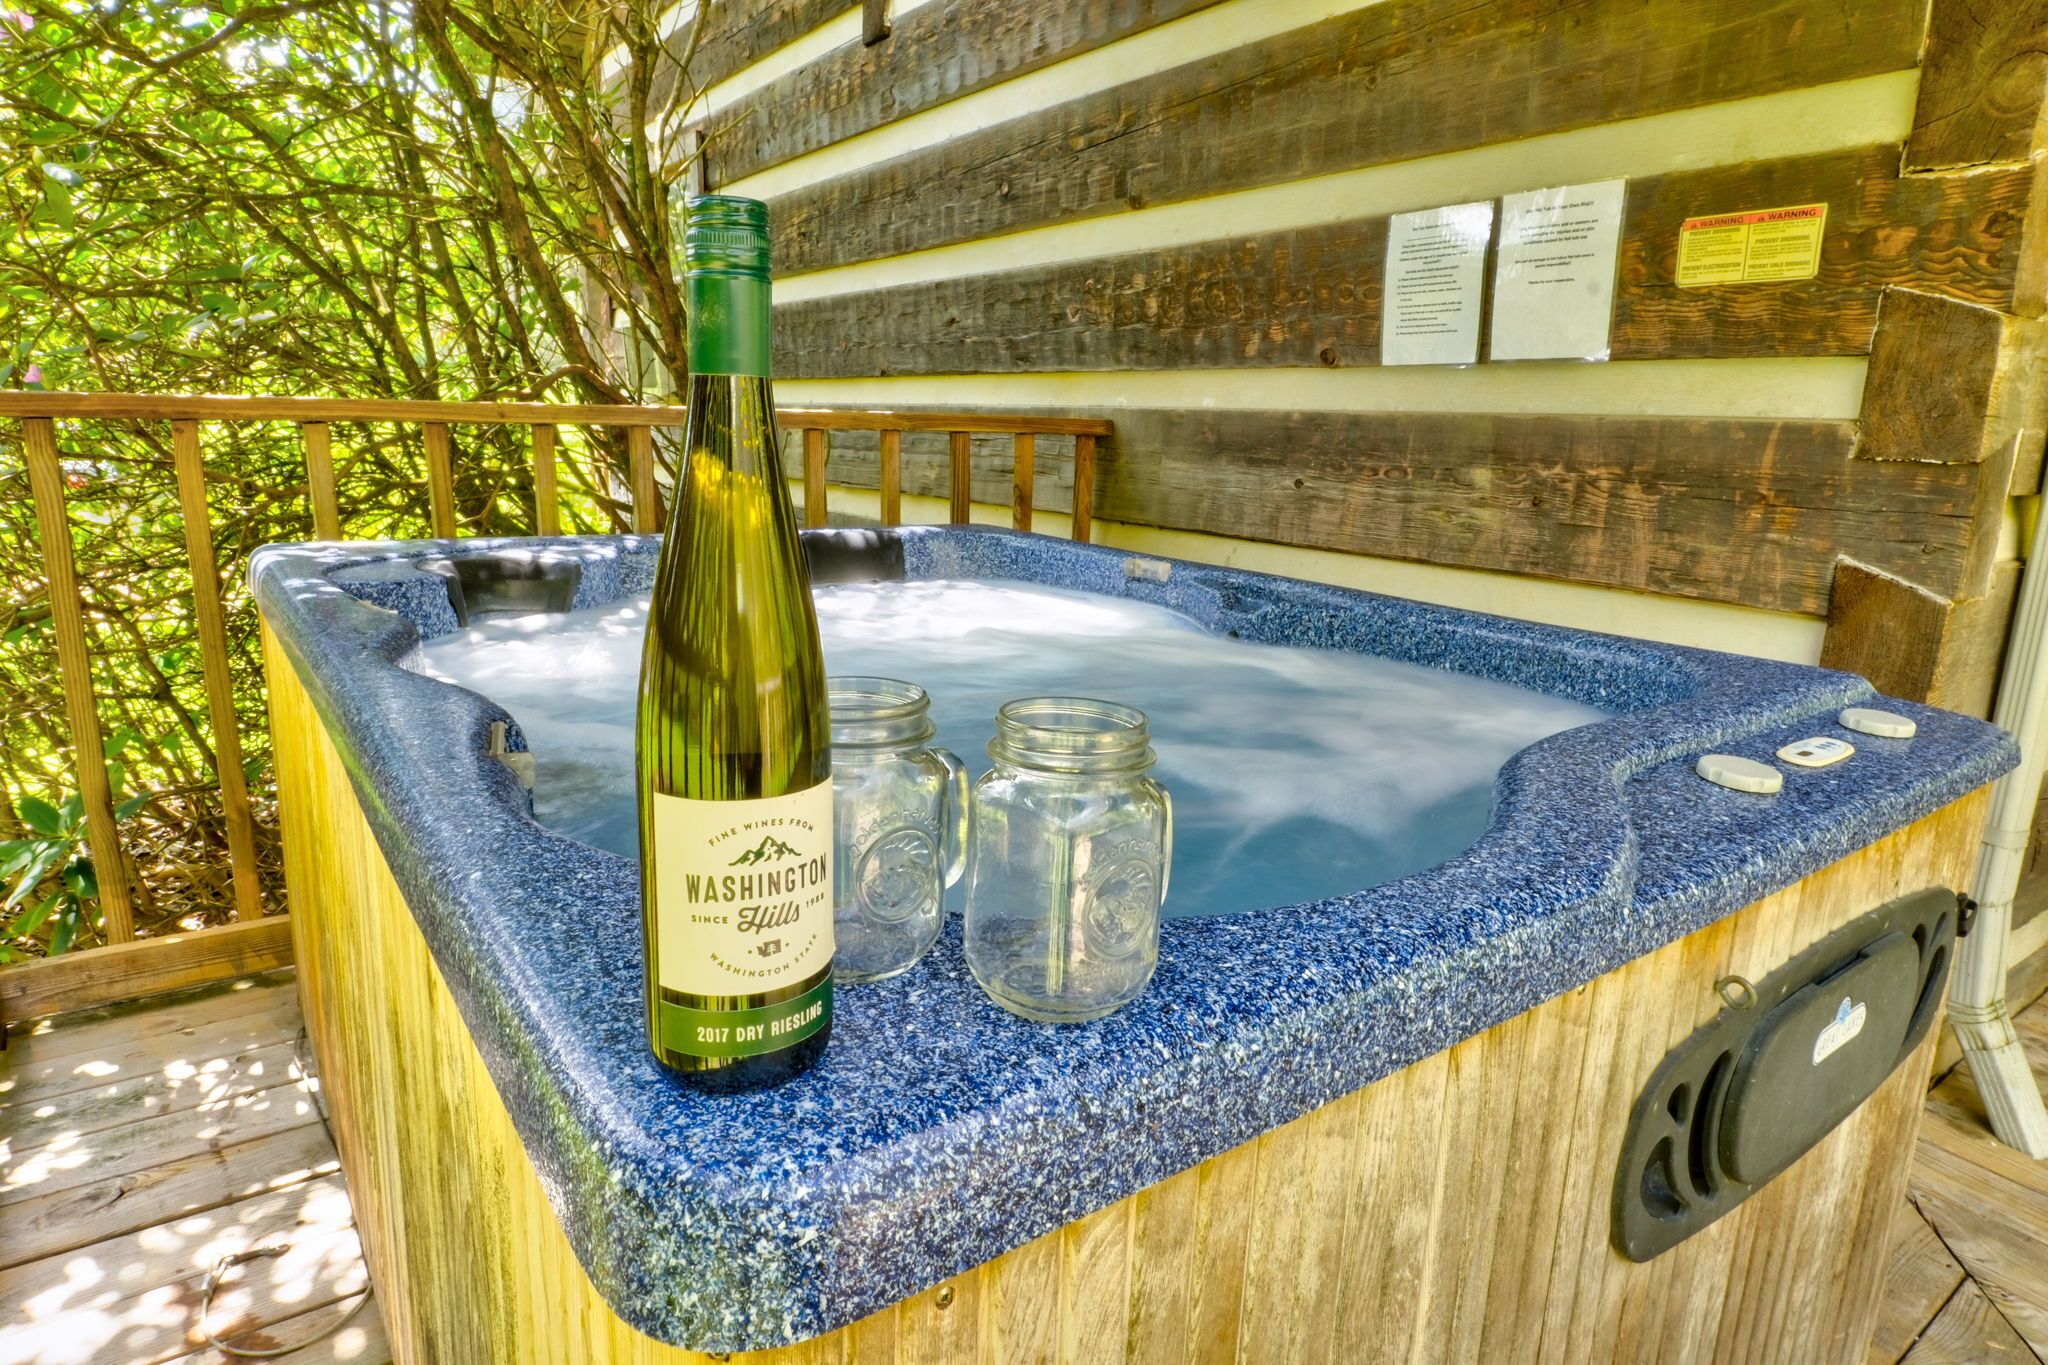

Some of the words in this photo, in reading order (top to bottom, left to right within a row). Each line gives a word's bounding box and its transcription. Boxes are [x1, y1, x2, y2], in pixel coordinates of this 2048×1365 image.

[1700, 217, 1743, 227] WARNING
[1768, 209, 1816, 220] WARNING
[708, 827, 738, 848] FINE
[743, 818, 784, 831] WINES
[789, 818, 814, 832] FROM
[686, 852, 828, 904] WASHINGTON
[690, 914, 729, 924] SINCE
[737, 902, 800, 936] Hills
[806, 892, 826, 909] 1988
[709, 952, 790, 978] WASHINGTON
[794, 933, 818, 965] STATE
[697, 1026, 730, 1043] 2017
[736, 1024, 765, 1042] DRY
[771, 1000, 823, 1037] RIESLING
